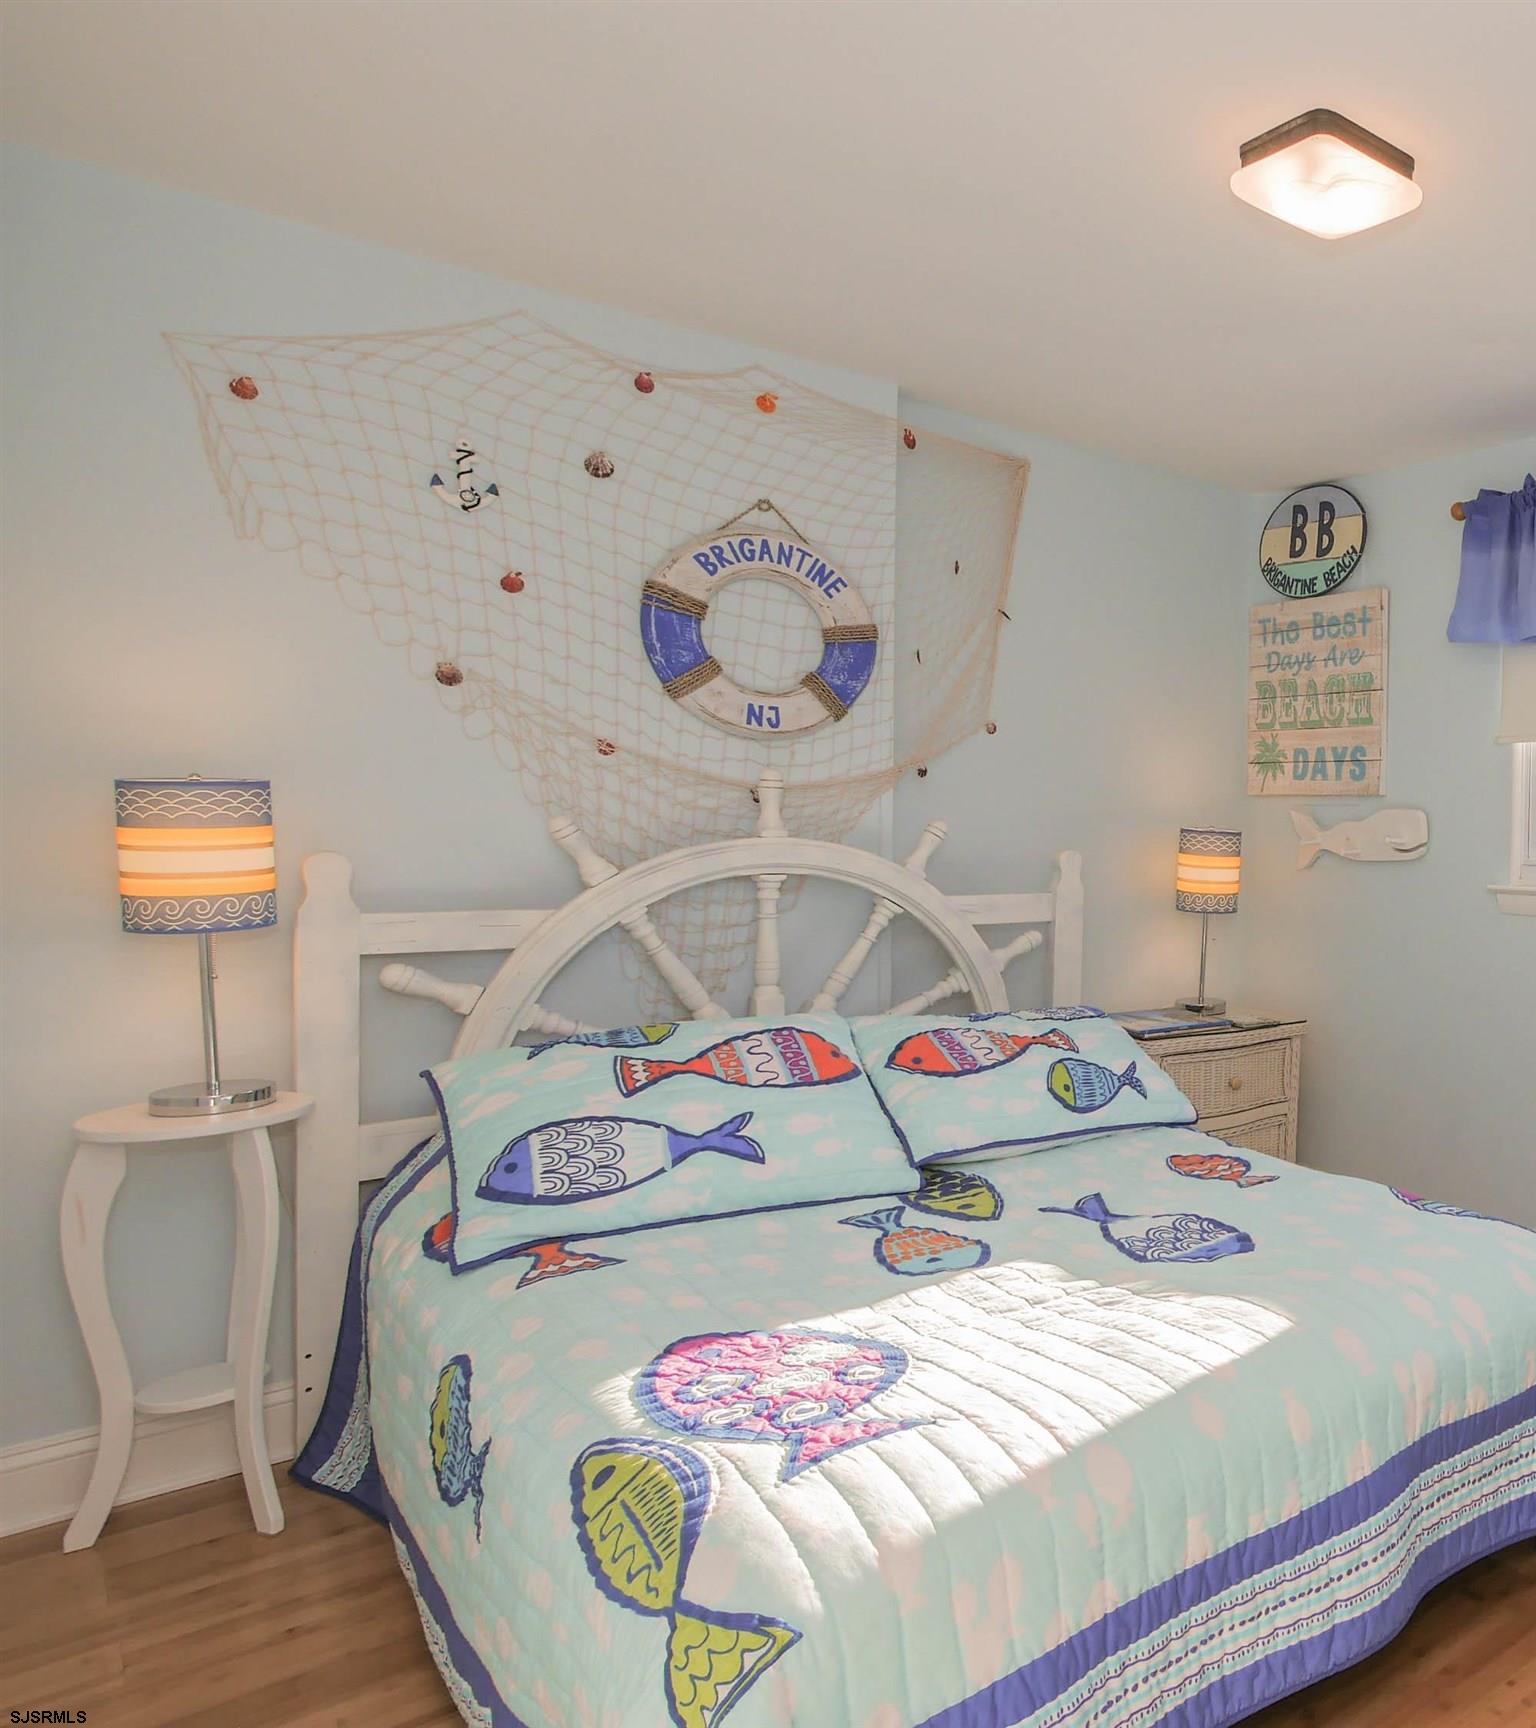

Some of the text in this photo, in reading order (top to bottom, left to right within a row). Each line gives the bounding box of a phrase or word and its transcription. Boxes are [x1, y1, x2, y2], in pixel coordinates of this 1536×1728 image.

[693, 538, 848, 599] BRIGANTINE
[1262, 545, 1358, 595] BRIGANTINE BEACH
[1257, 606, 1371, 646] The Best
[1266, 645, 1366, 676] Days Are
[746, 703, 781, 729] NJ
[1255, 672, 1374, 730] BEACH
[1292, 746, 1368, 781] DAYS
